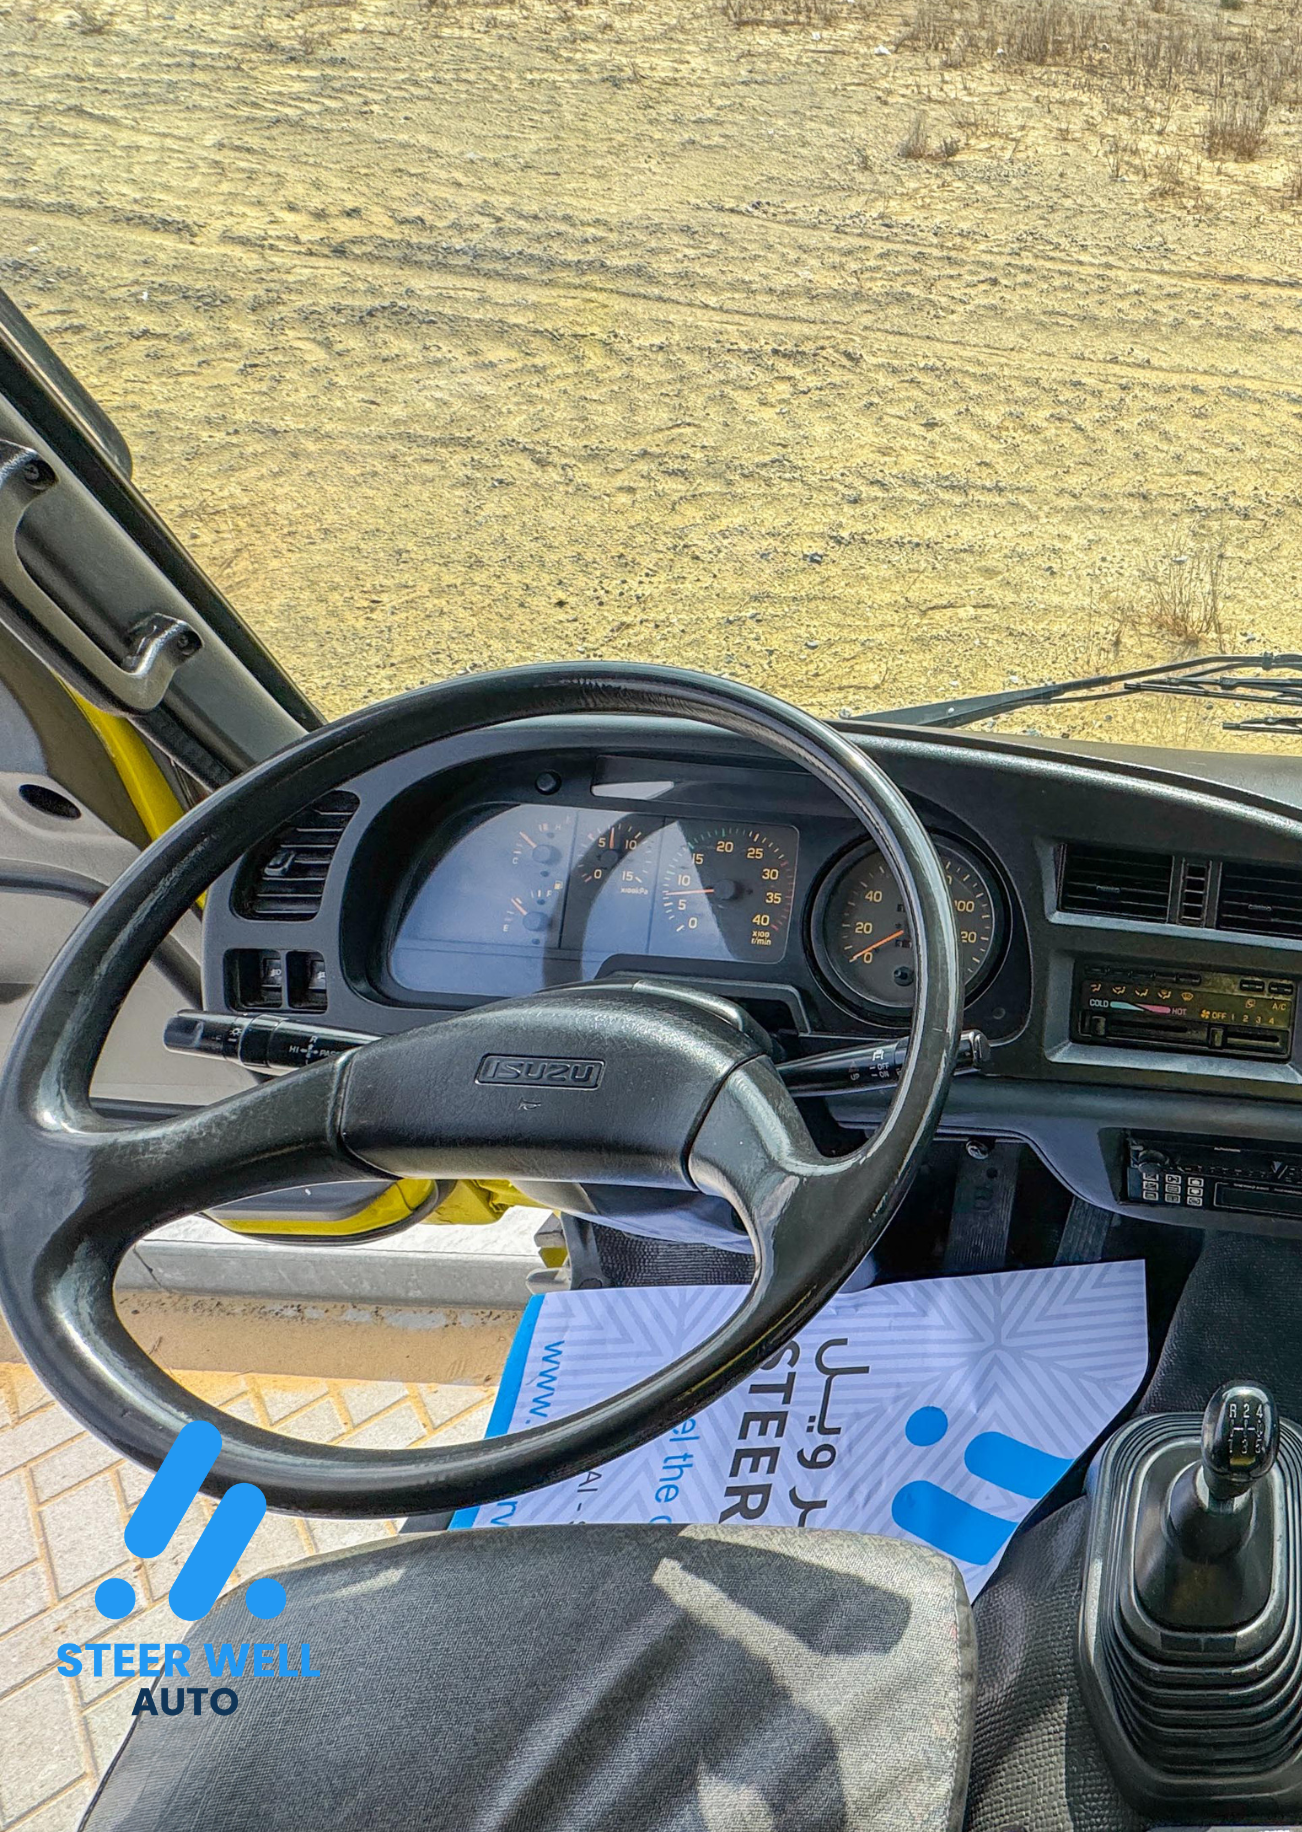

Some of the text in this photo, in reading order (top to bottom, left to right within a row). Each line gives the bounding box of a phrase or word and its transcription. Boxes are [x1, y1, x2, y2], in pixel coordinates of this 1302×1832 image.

[597, 838, 606, 848] 5
[625, 839, 637, 850] 10
[716, 841, 734, 853] 20
[692, 853, 704, 865] 15
[747, 848, 764, 860] 25
[594, 869, 602, 879] 0
[622, 870, 634, 881] 15
[762, 868, 779, 880] 30
[678, 874, 691, 887] 10
[765, 892, 782, 904] 35
[865, 890, 882, 902] 40
[678, 899, 687, 911] 5
[688, 917, 698, 929] 0
[752, 914, 770, 926] 40
[855, 922, 873, 934] 20
[863, 952, 873, 964] 0
[1089, 999, 1109, 1008] COLD
[1272, 1002, 1287, 1011] A/C
[1172, 1008, 1187, 1016] HOT
[1211, 1012, 1226, 1021] OFF
[1242, 1015, 1248, 1023] 2
[1255, 1016, 1262, 1024] 3
[1268, 1017, 1275, 1025] 4
[289, 1045, 300, 1054] HI
[486, 1061, 594, 1083] ISUZU
[877, 1062, 889, 1070] OFF
[1229, 1403, 1263, 1418] R 2 4
[718, 1340, 801, 1524] STEER
[1228, 1439, 1262, 1453] 1 3 5
[655, 1452, 694, 1504] the
